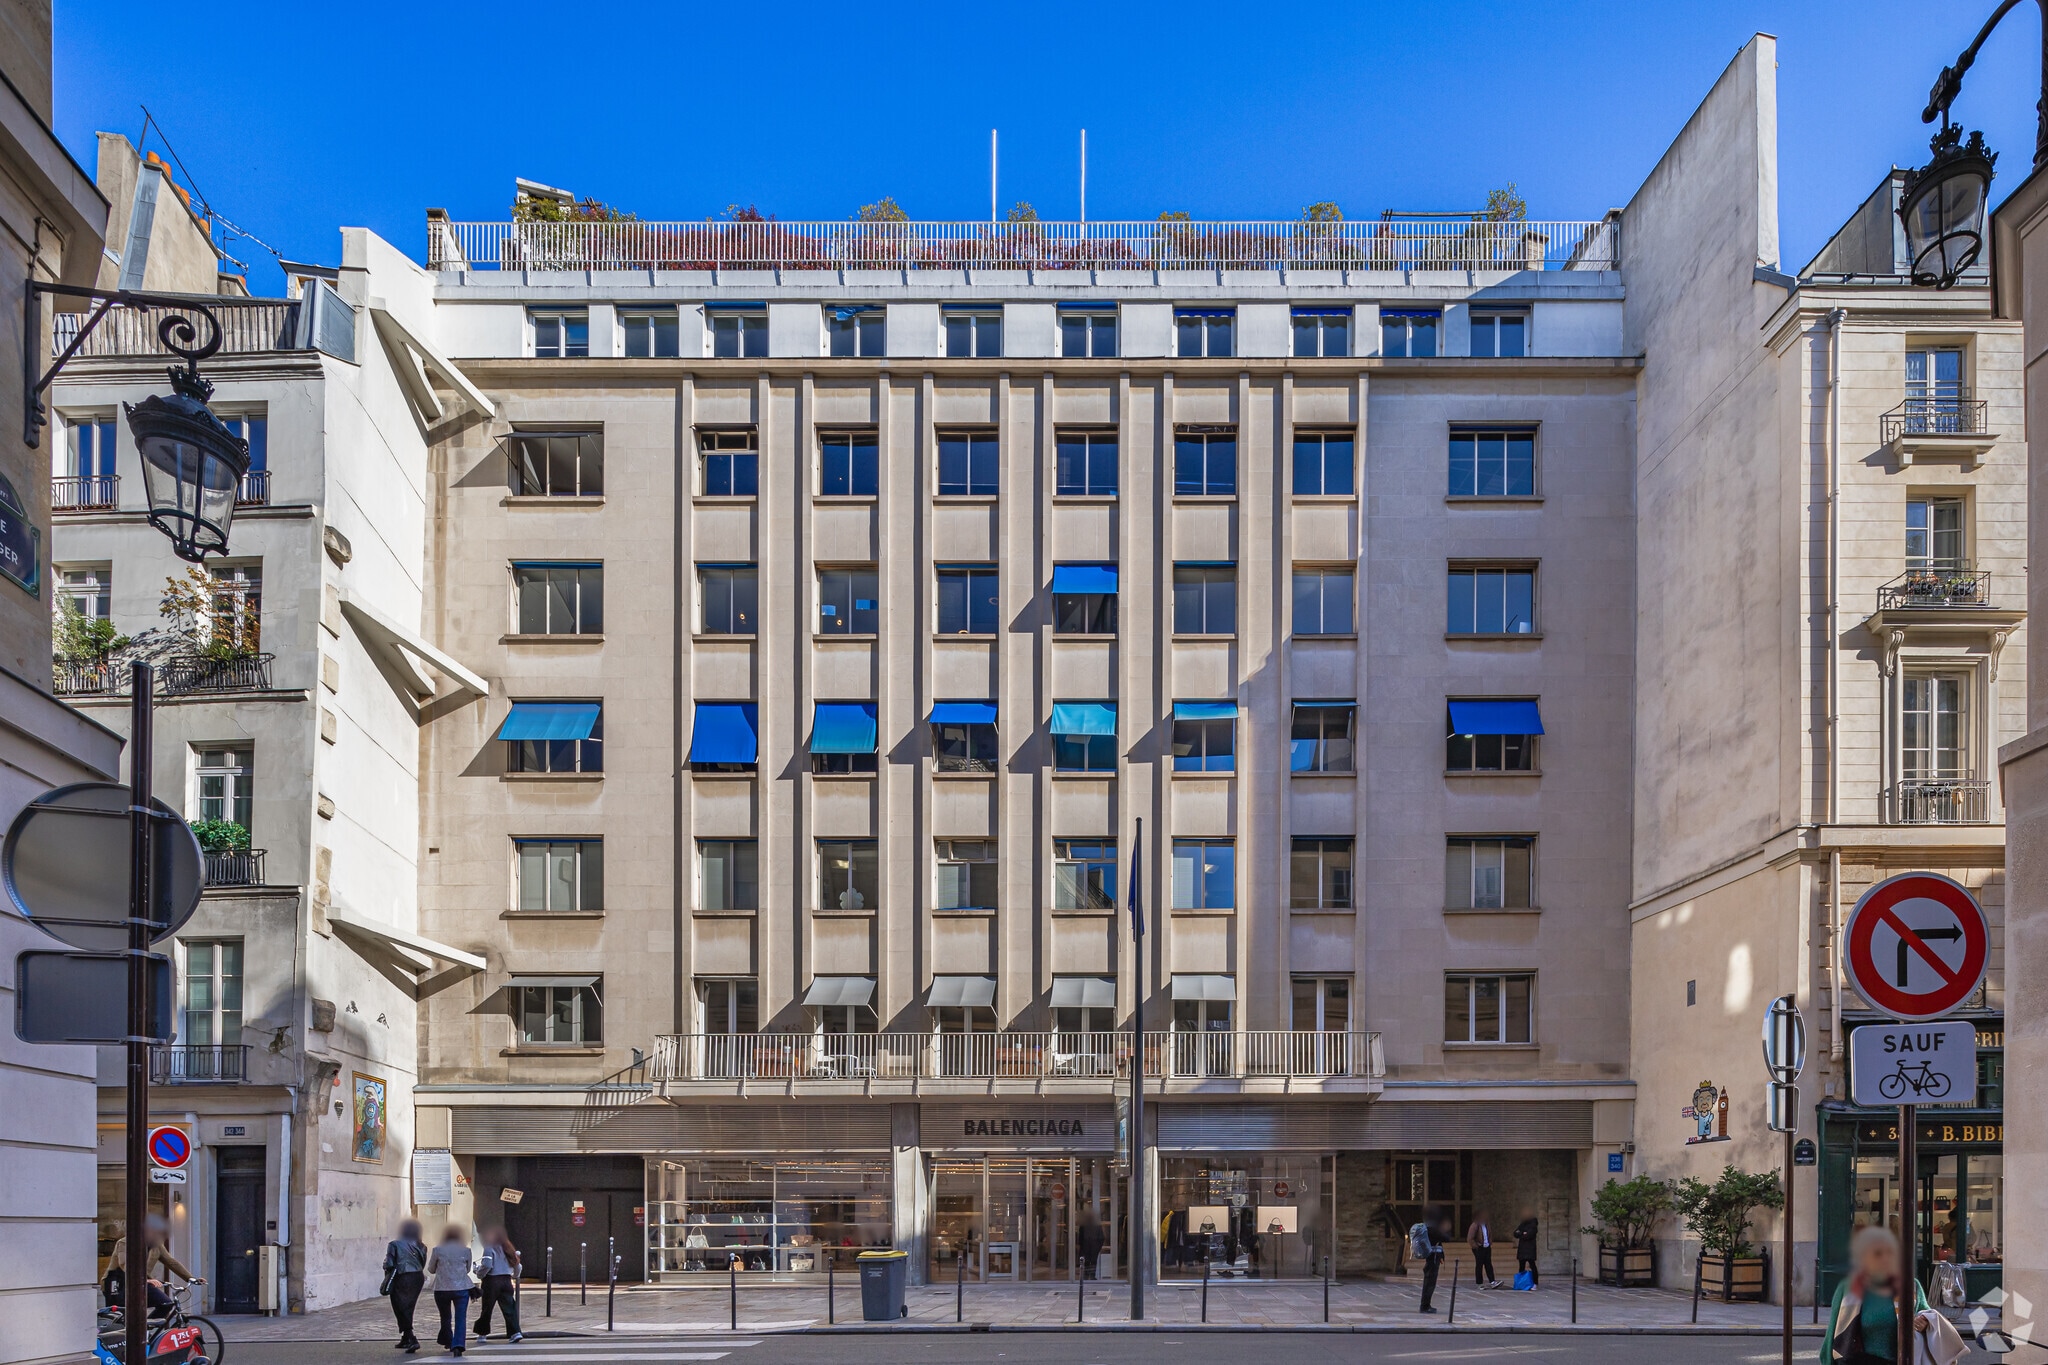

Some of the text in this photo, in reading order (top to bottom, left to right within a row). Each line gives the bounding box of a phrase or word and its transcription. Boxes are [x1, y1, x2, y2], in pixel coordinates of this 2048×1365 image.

[1883, 1032, 1946, 1053] SAUF
[964, 1119, 1084, 1136] BALENCIAGA
[1888, 1127, 1900, 1140] 3
